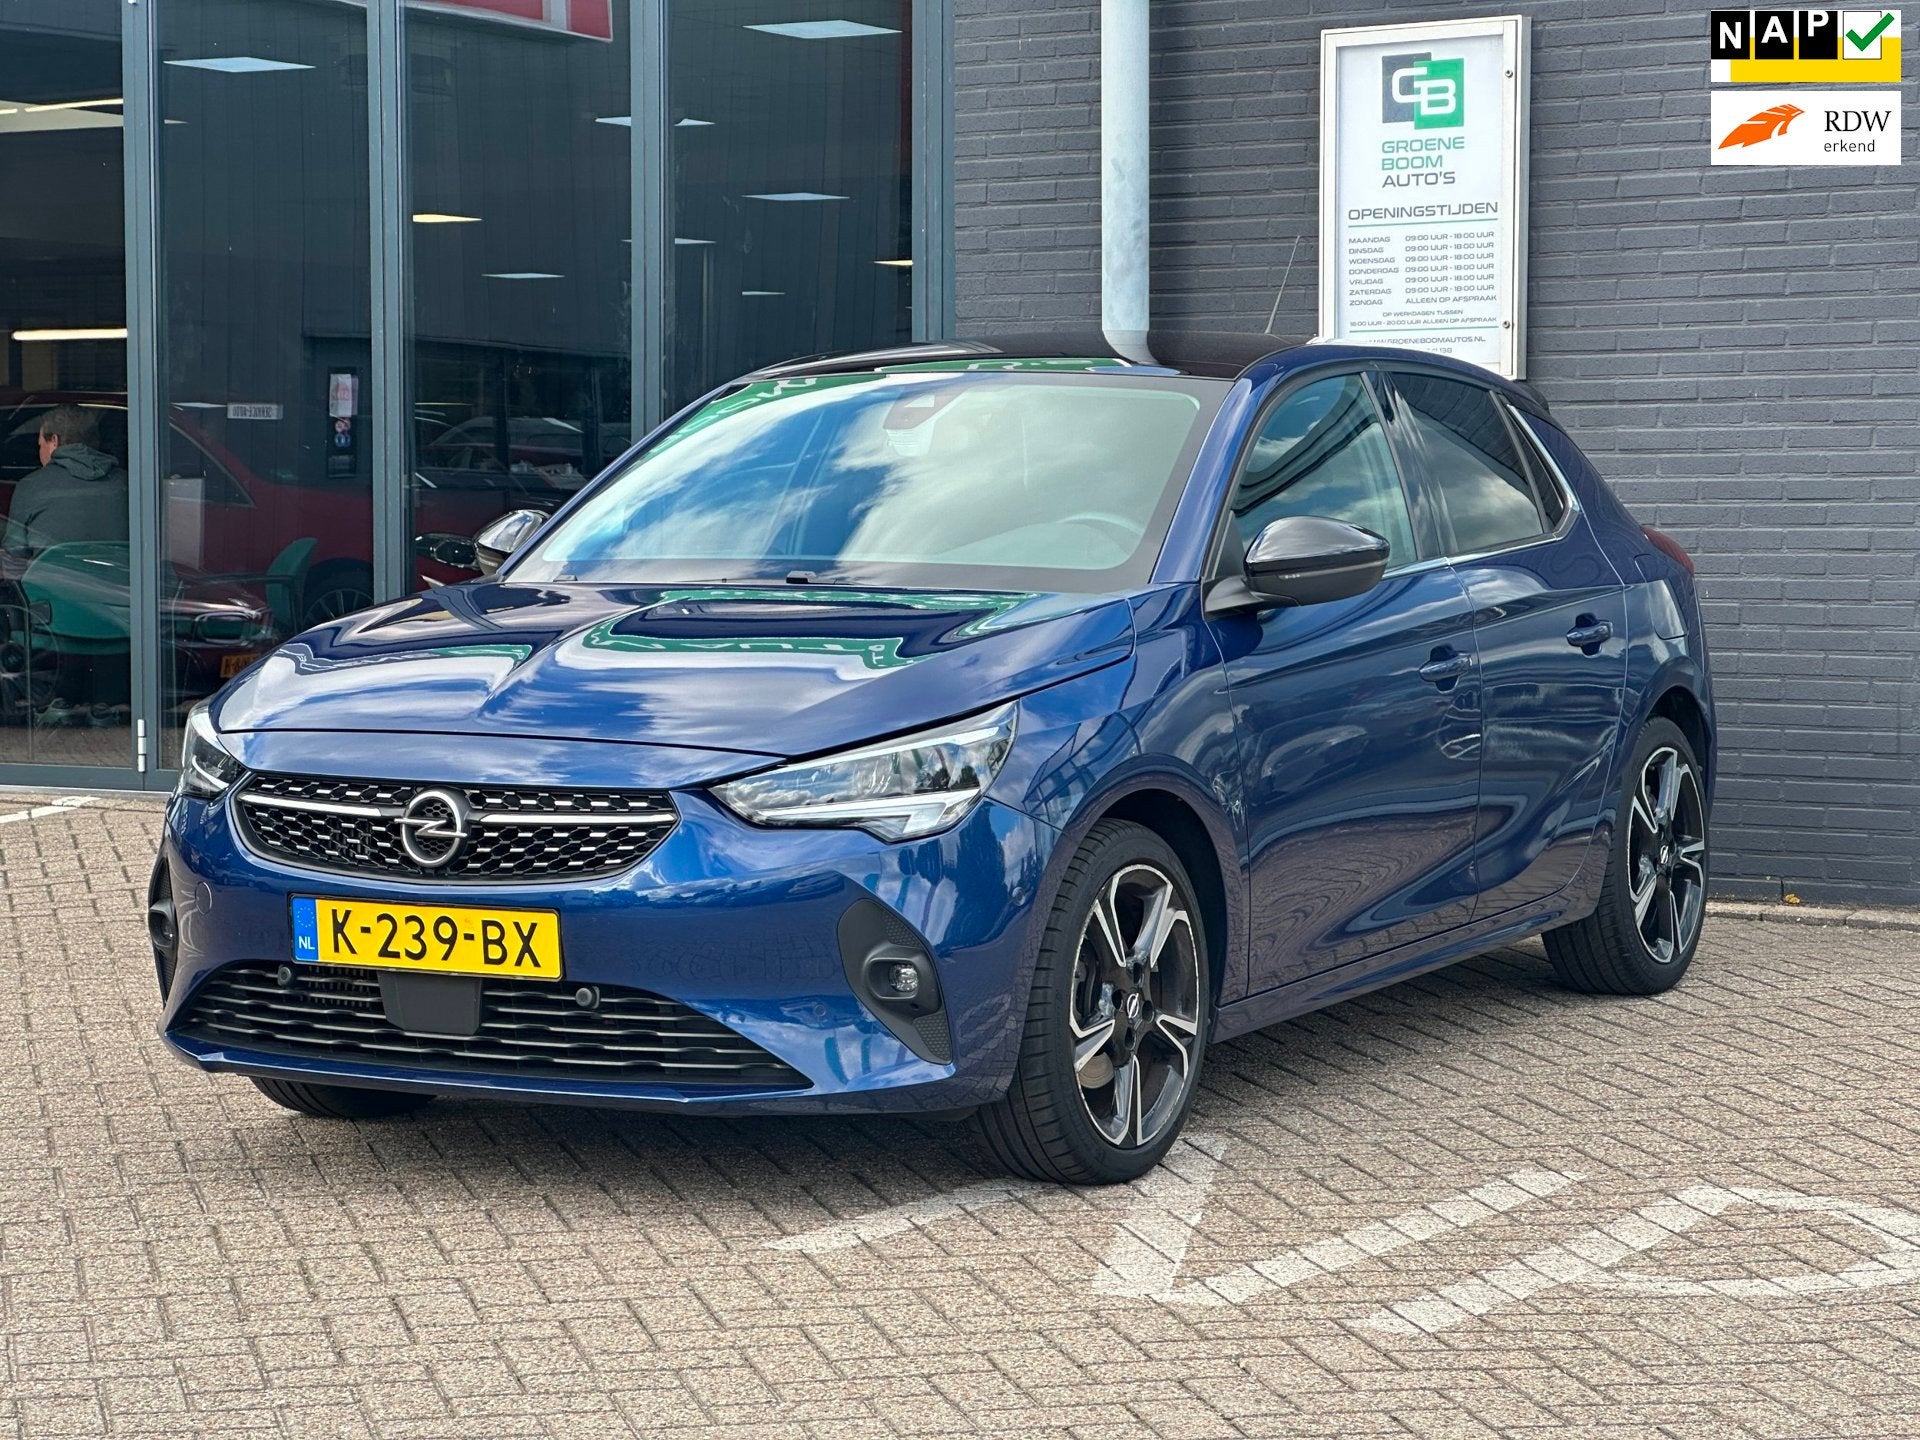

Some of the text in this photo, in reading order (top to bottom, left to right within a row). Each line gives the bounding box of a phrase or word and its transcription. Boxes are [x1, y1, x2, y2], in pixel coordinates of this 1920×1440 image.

[1382, 136, 1464, 153] GROENE
[1382, 155, 1443, 171] BOOM
[1382, 171, 1455, 188] AUTO'S
[1348, 202, 1498, 221] OPENINGSTIJDEN
[1349, 236, 1391, 244] MAANDAG
[1349, 257, 1395, 265] WOENSDAG
[1349, 267, 1399, 275] DONDERDAG
[1406, 296, 1437, 304] ALLEEN
[1452, 294, 1497, 302] AFSPRAAK
[298, 908, 541, 968] NL K-239-BX
